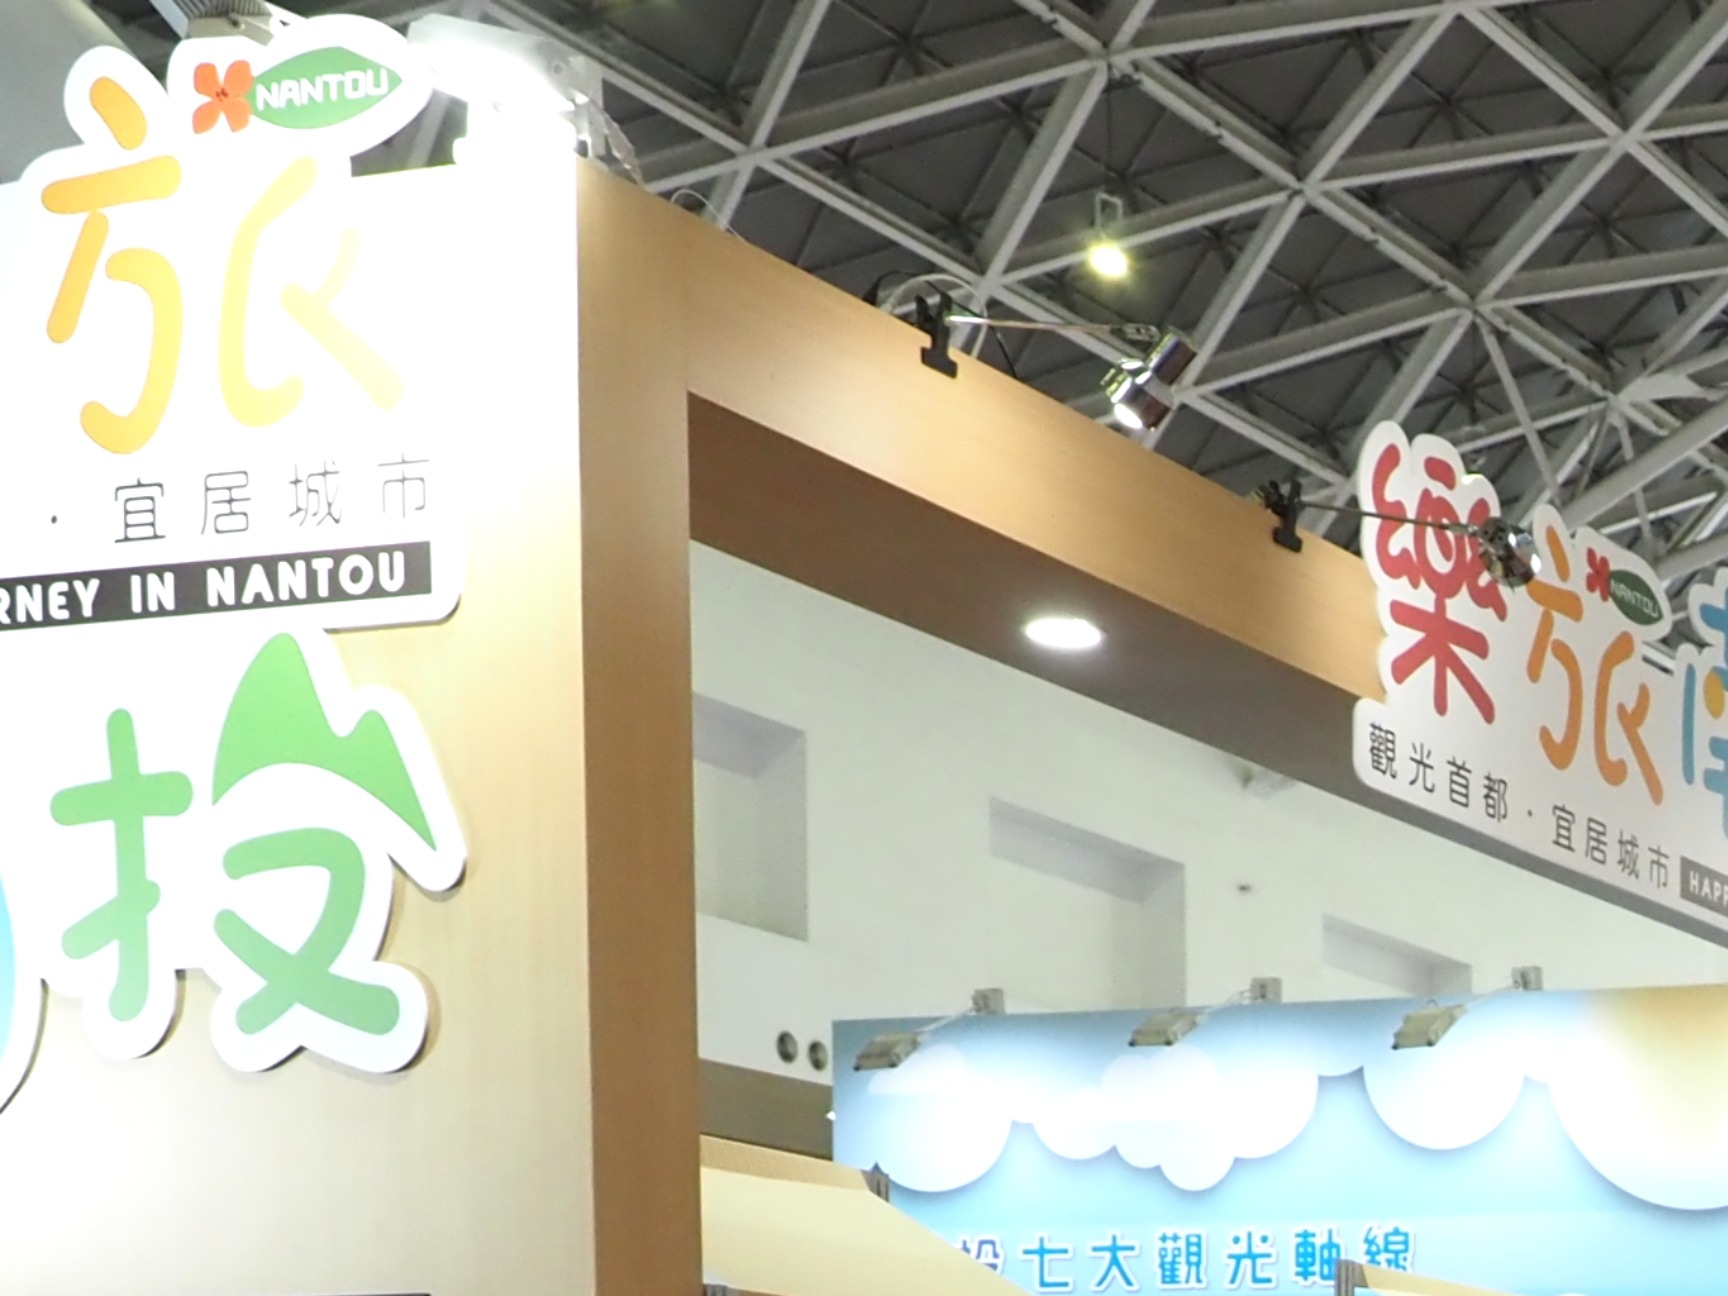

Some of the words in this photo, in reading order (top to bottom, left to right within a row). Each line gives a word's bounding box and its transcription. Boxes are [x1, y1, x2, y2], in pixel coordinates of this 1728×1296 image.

[255, 67, 389, 110] NANTOU
[41, 76, 402, 454] 旅
[130, 571, 176, 614] IN
[206, 550, 405, 607] NANTOU
[50, 633, 437, 1036] 投
